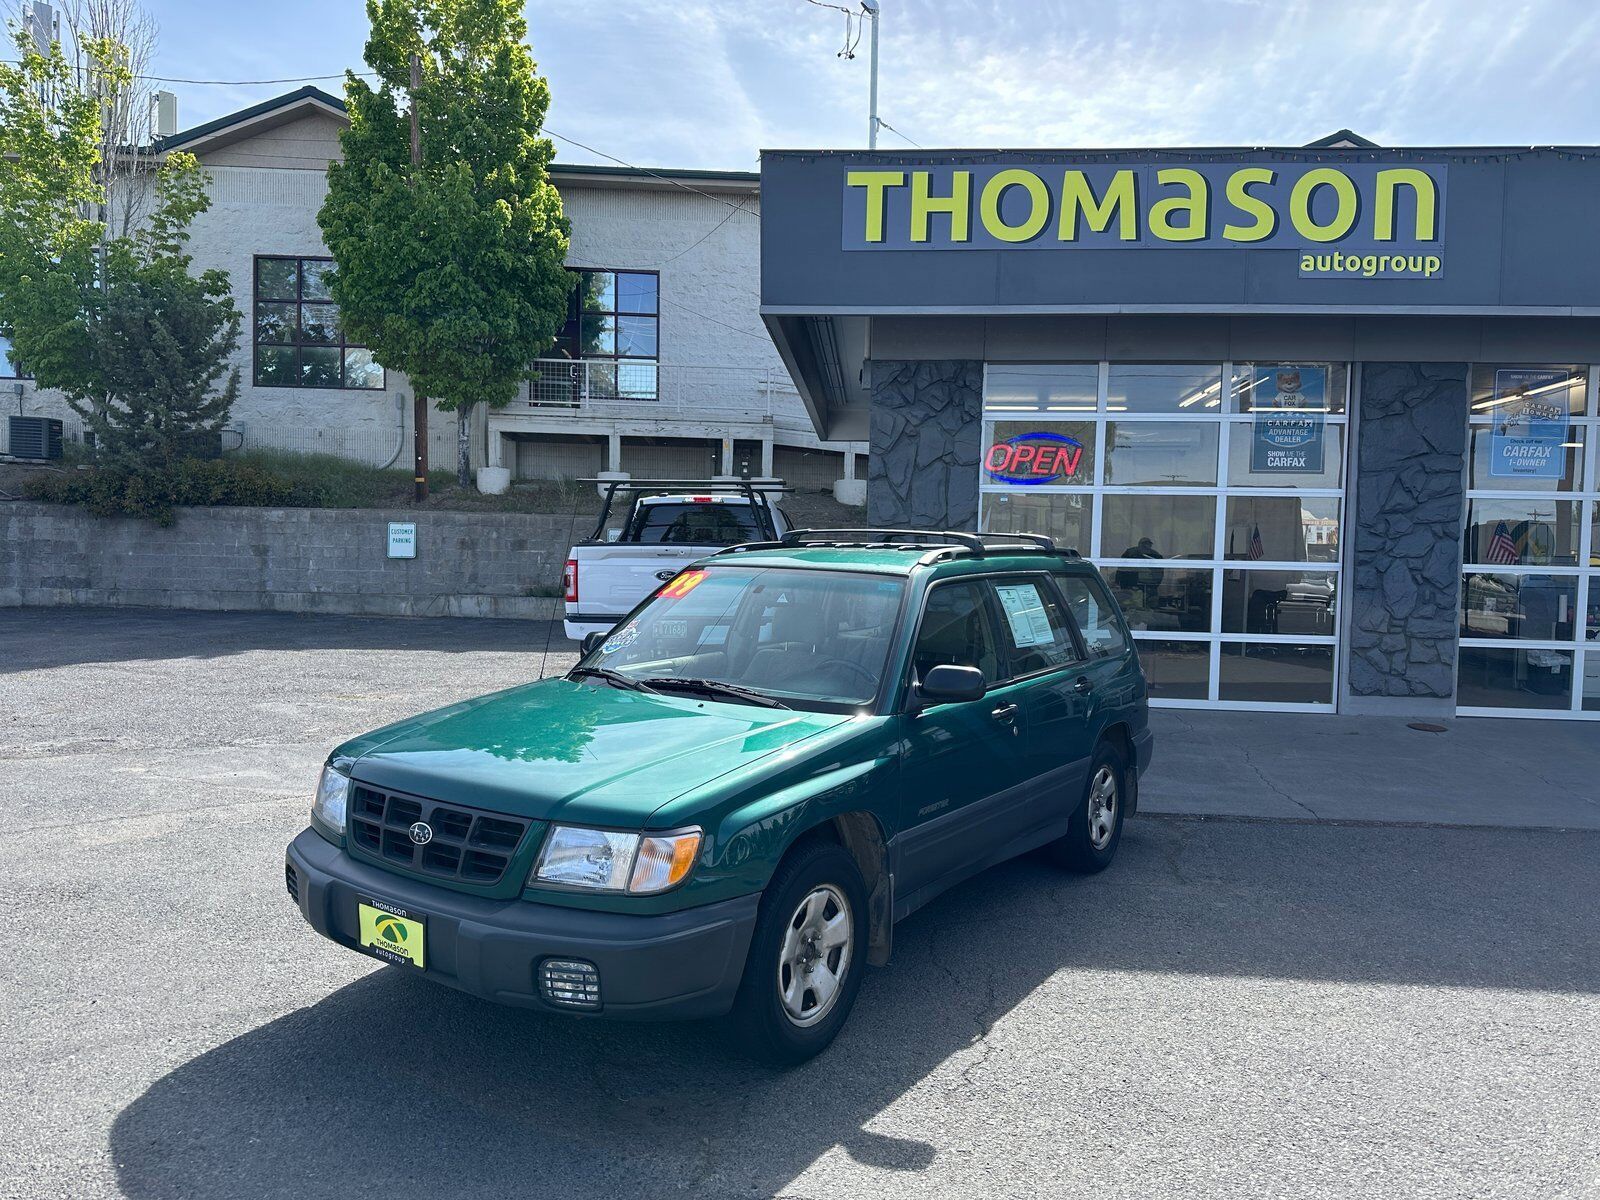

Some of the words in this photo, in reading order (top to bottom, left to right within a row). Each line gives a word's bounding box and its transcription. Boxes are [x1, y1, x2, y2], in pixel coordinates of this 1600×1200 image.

[1299, 251, 1441, 279] autogroup
[1268, 428, 1308, 436] ADVANTAGE
[1503, 446, 1552, 457] CARFAX
[984, 444, 1082, 476] OPEN
[1267, 457, 1306, 467] CARFAX
[1508, 458, 1546, 467] 1-OWNER
[376, 949, 405, 964] autogroup
